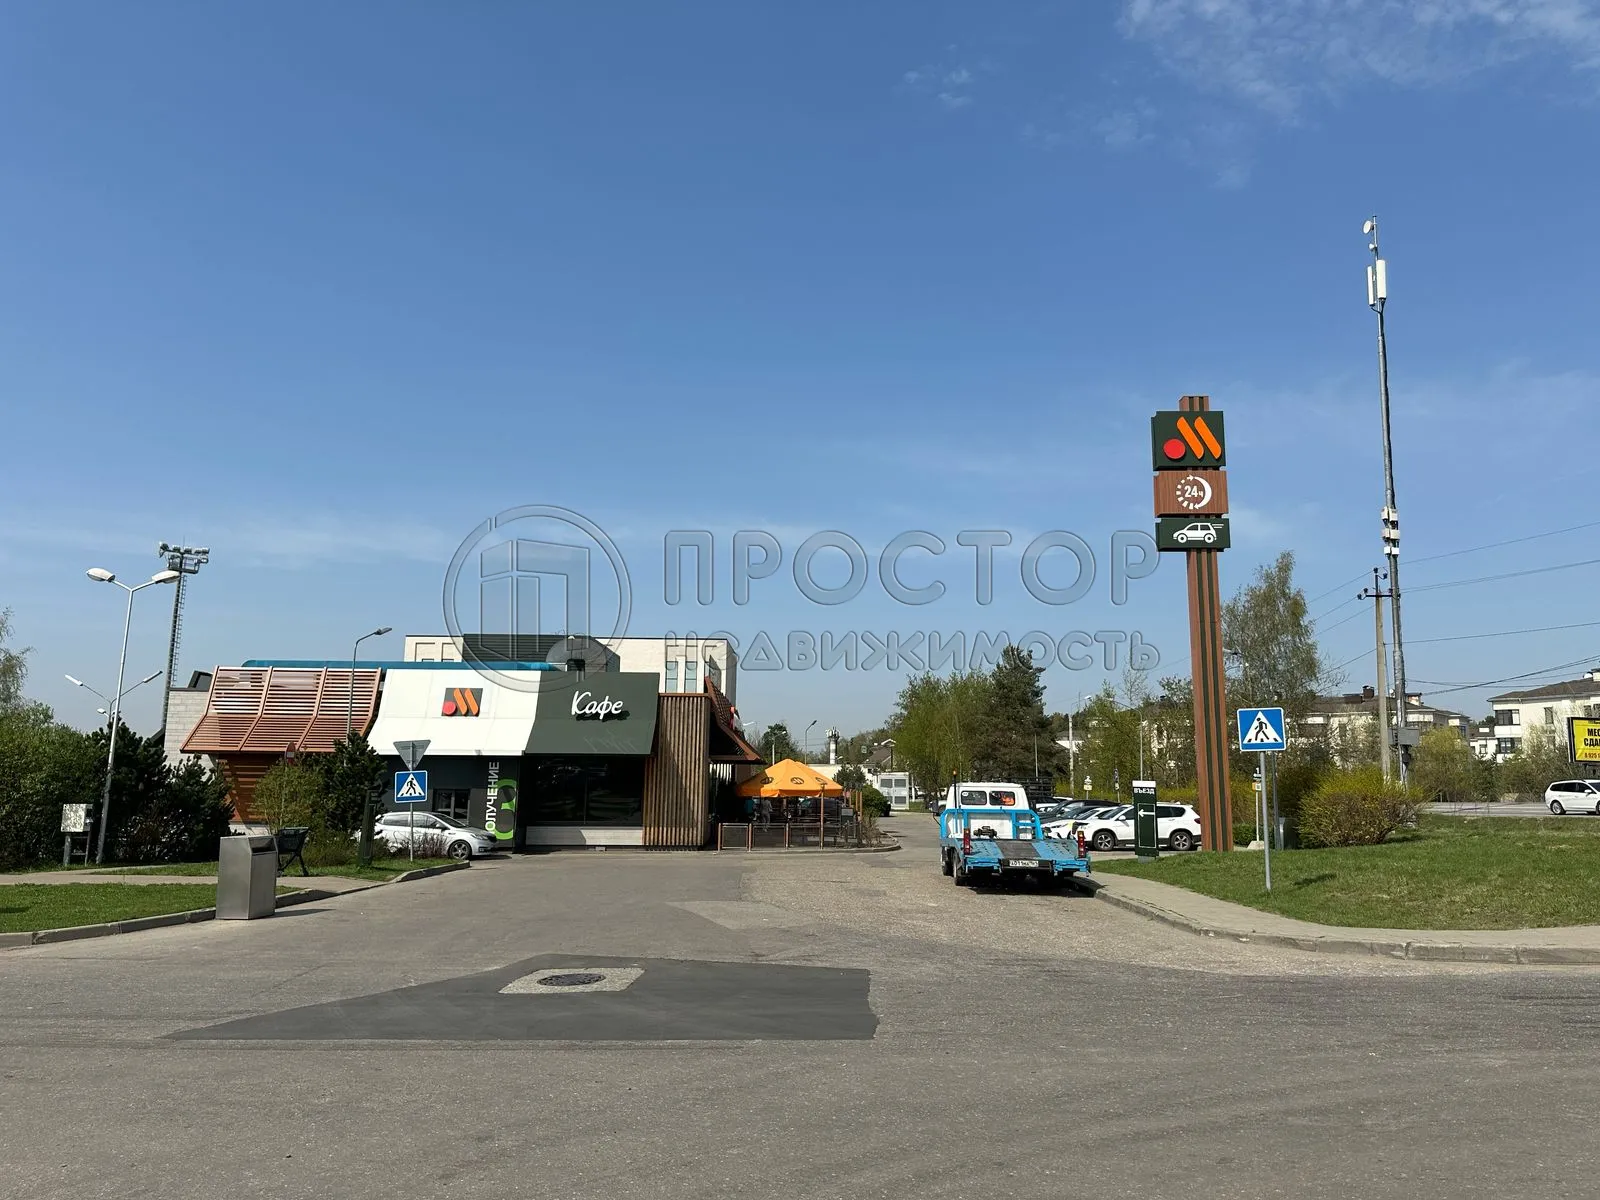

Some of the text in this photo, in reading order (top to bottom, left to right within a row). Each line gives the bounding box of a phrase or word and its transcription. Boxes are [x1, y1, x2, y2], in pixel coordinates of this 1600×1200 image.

[571, 690, 624, 720] Кафе
[485, 761, 500, 834] ОЛУЧЕНИЕ
[1133, 787, 1155, 795] ВЪЕЗД
